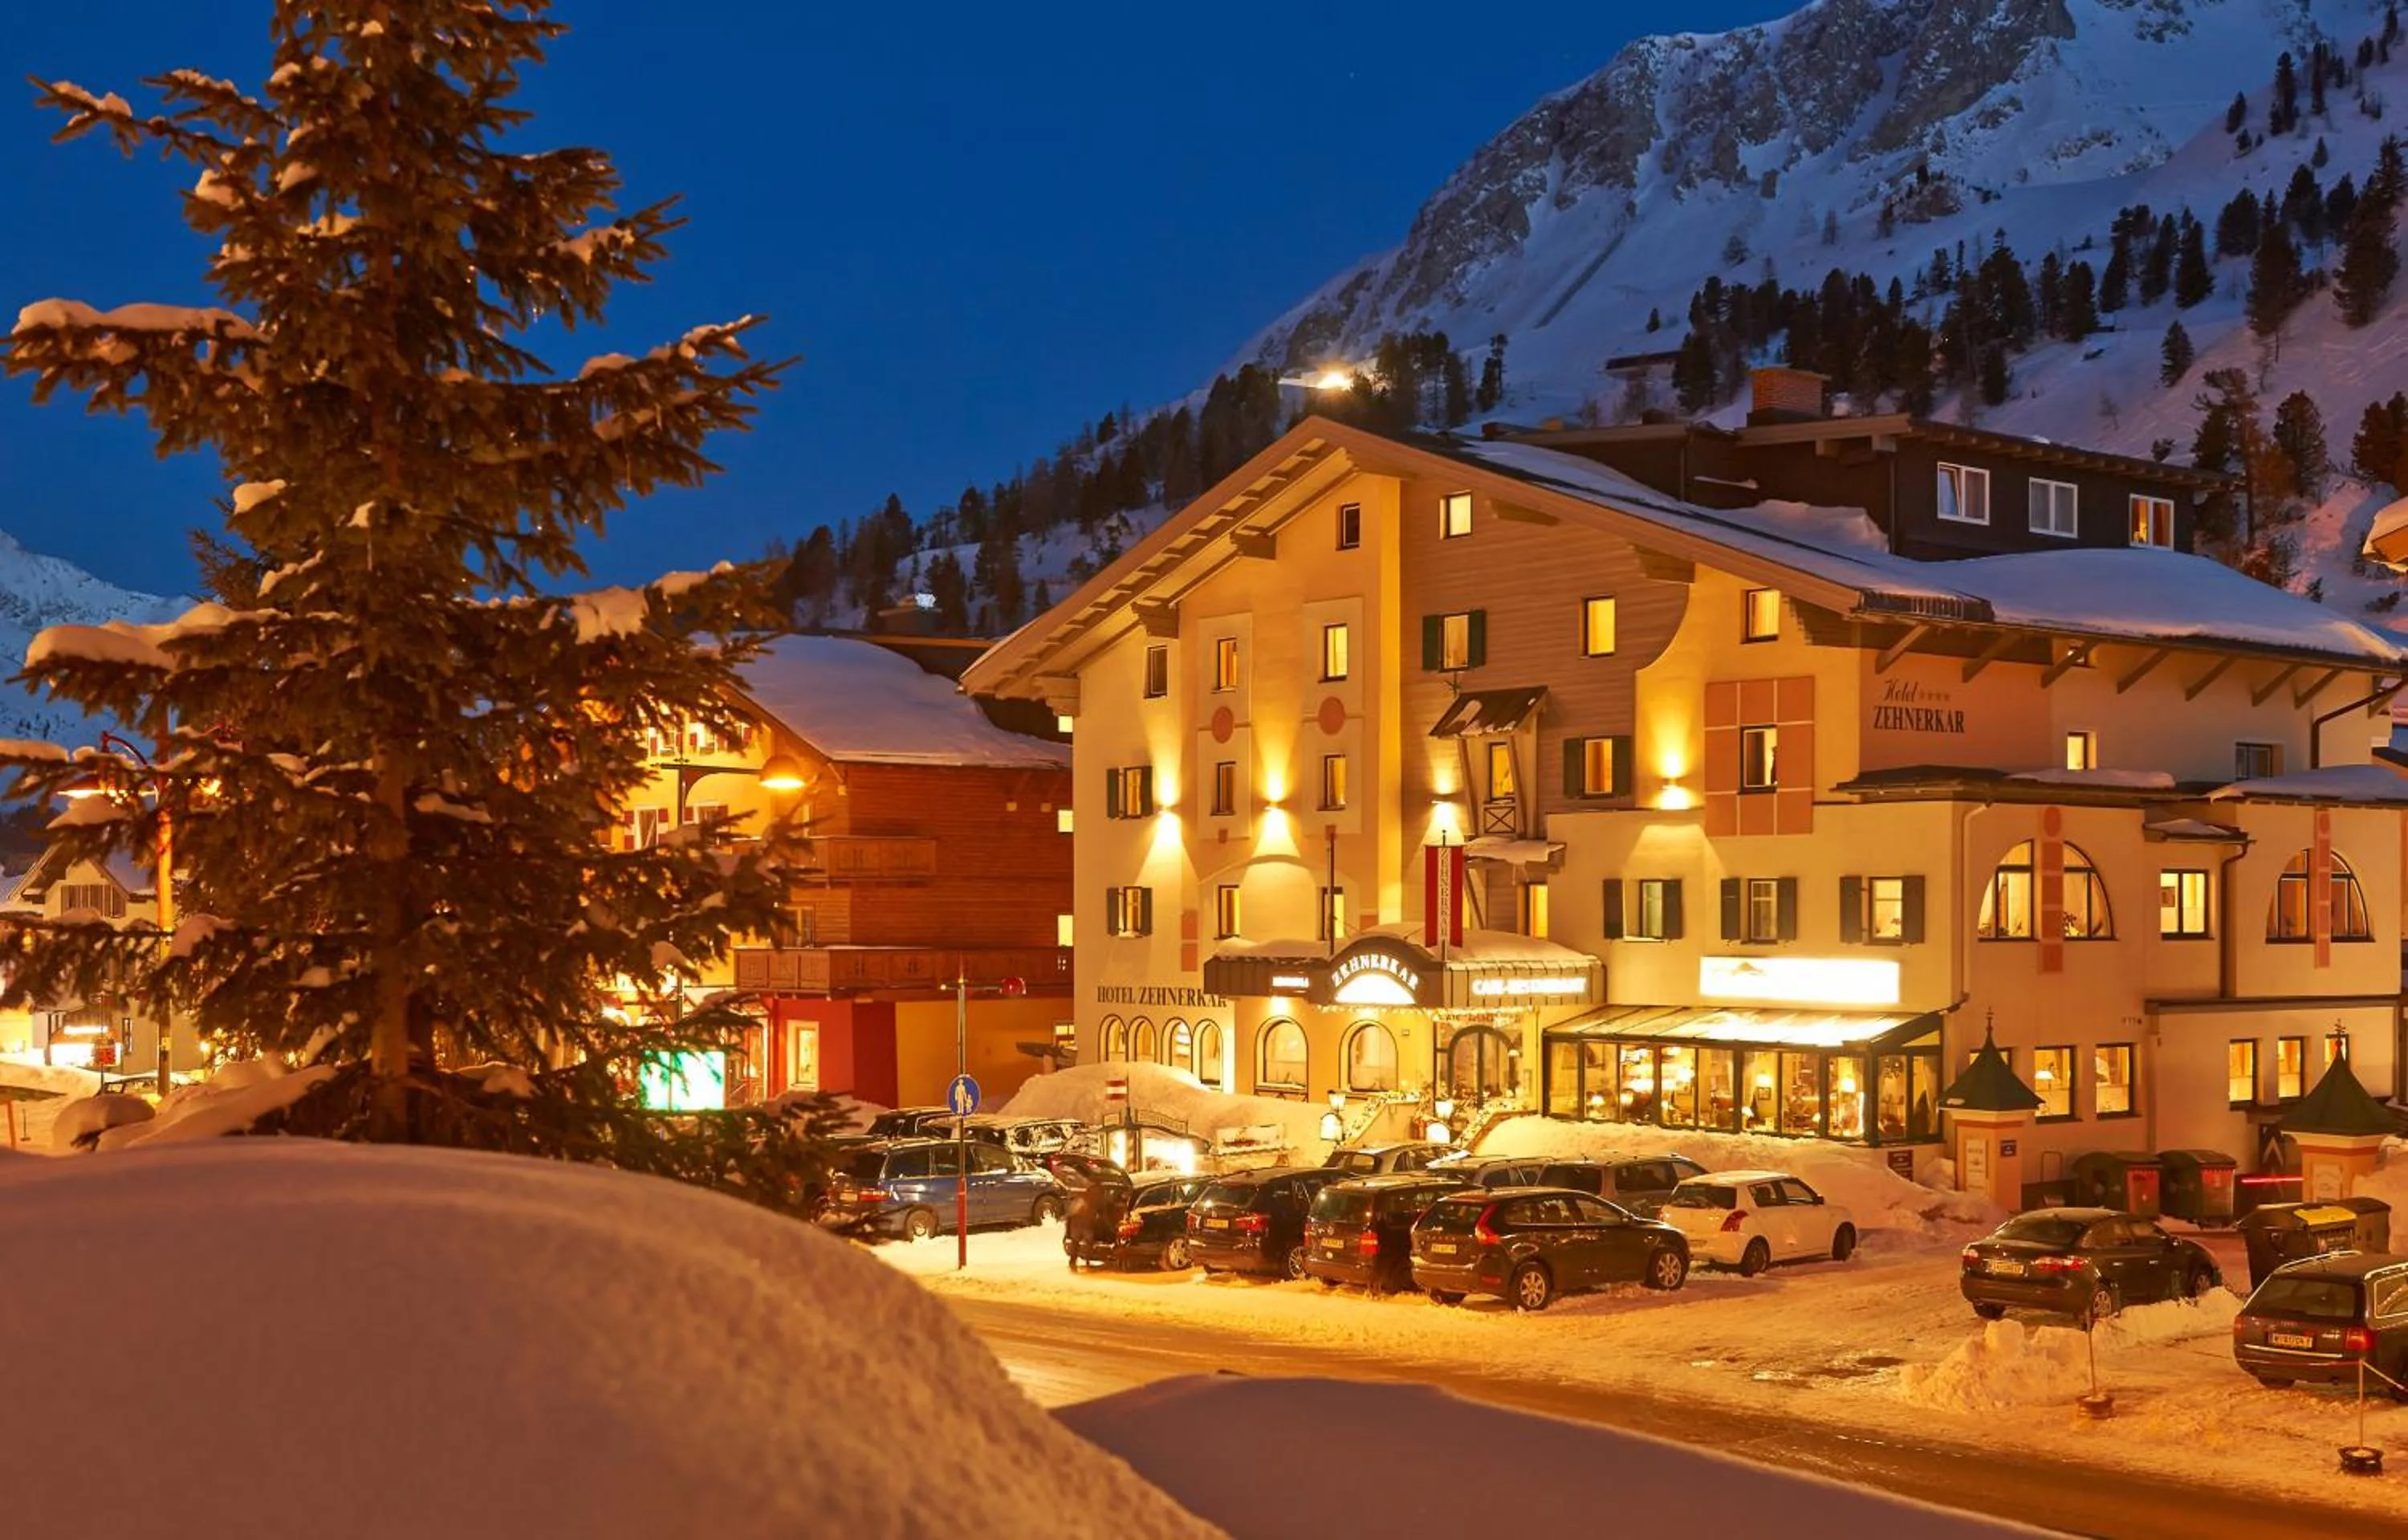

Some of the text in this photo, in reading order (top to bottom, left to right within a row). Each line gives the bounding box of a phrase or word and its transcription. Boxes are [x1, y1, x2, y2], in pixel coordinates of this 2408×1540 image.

[1883, 678, 1918, 703] Hotel
[1873, 706, 1965, 733] ZEHNERKAR
[1441, 848, 1449, 936] ZEHNERKAR
[1332, 953, 1418, 990] ZEHNERKAR
[1097, 986, 1227, 1008] HOTEL ZEHNERKAR
